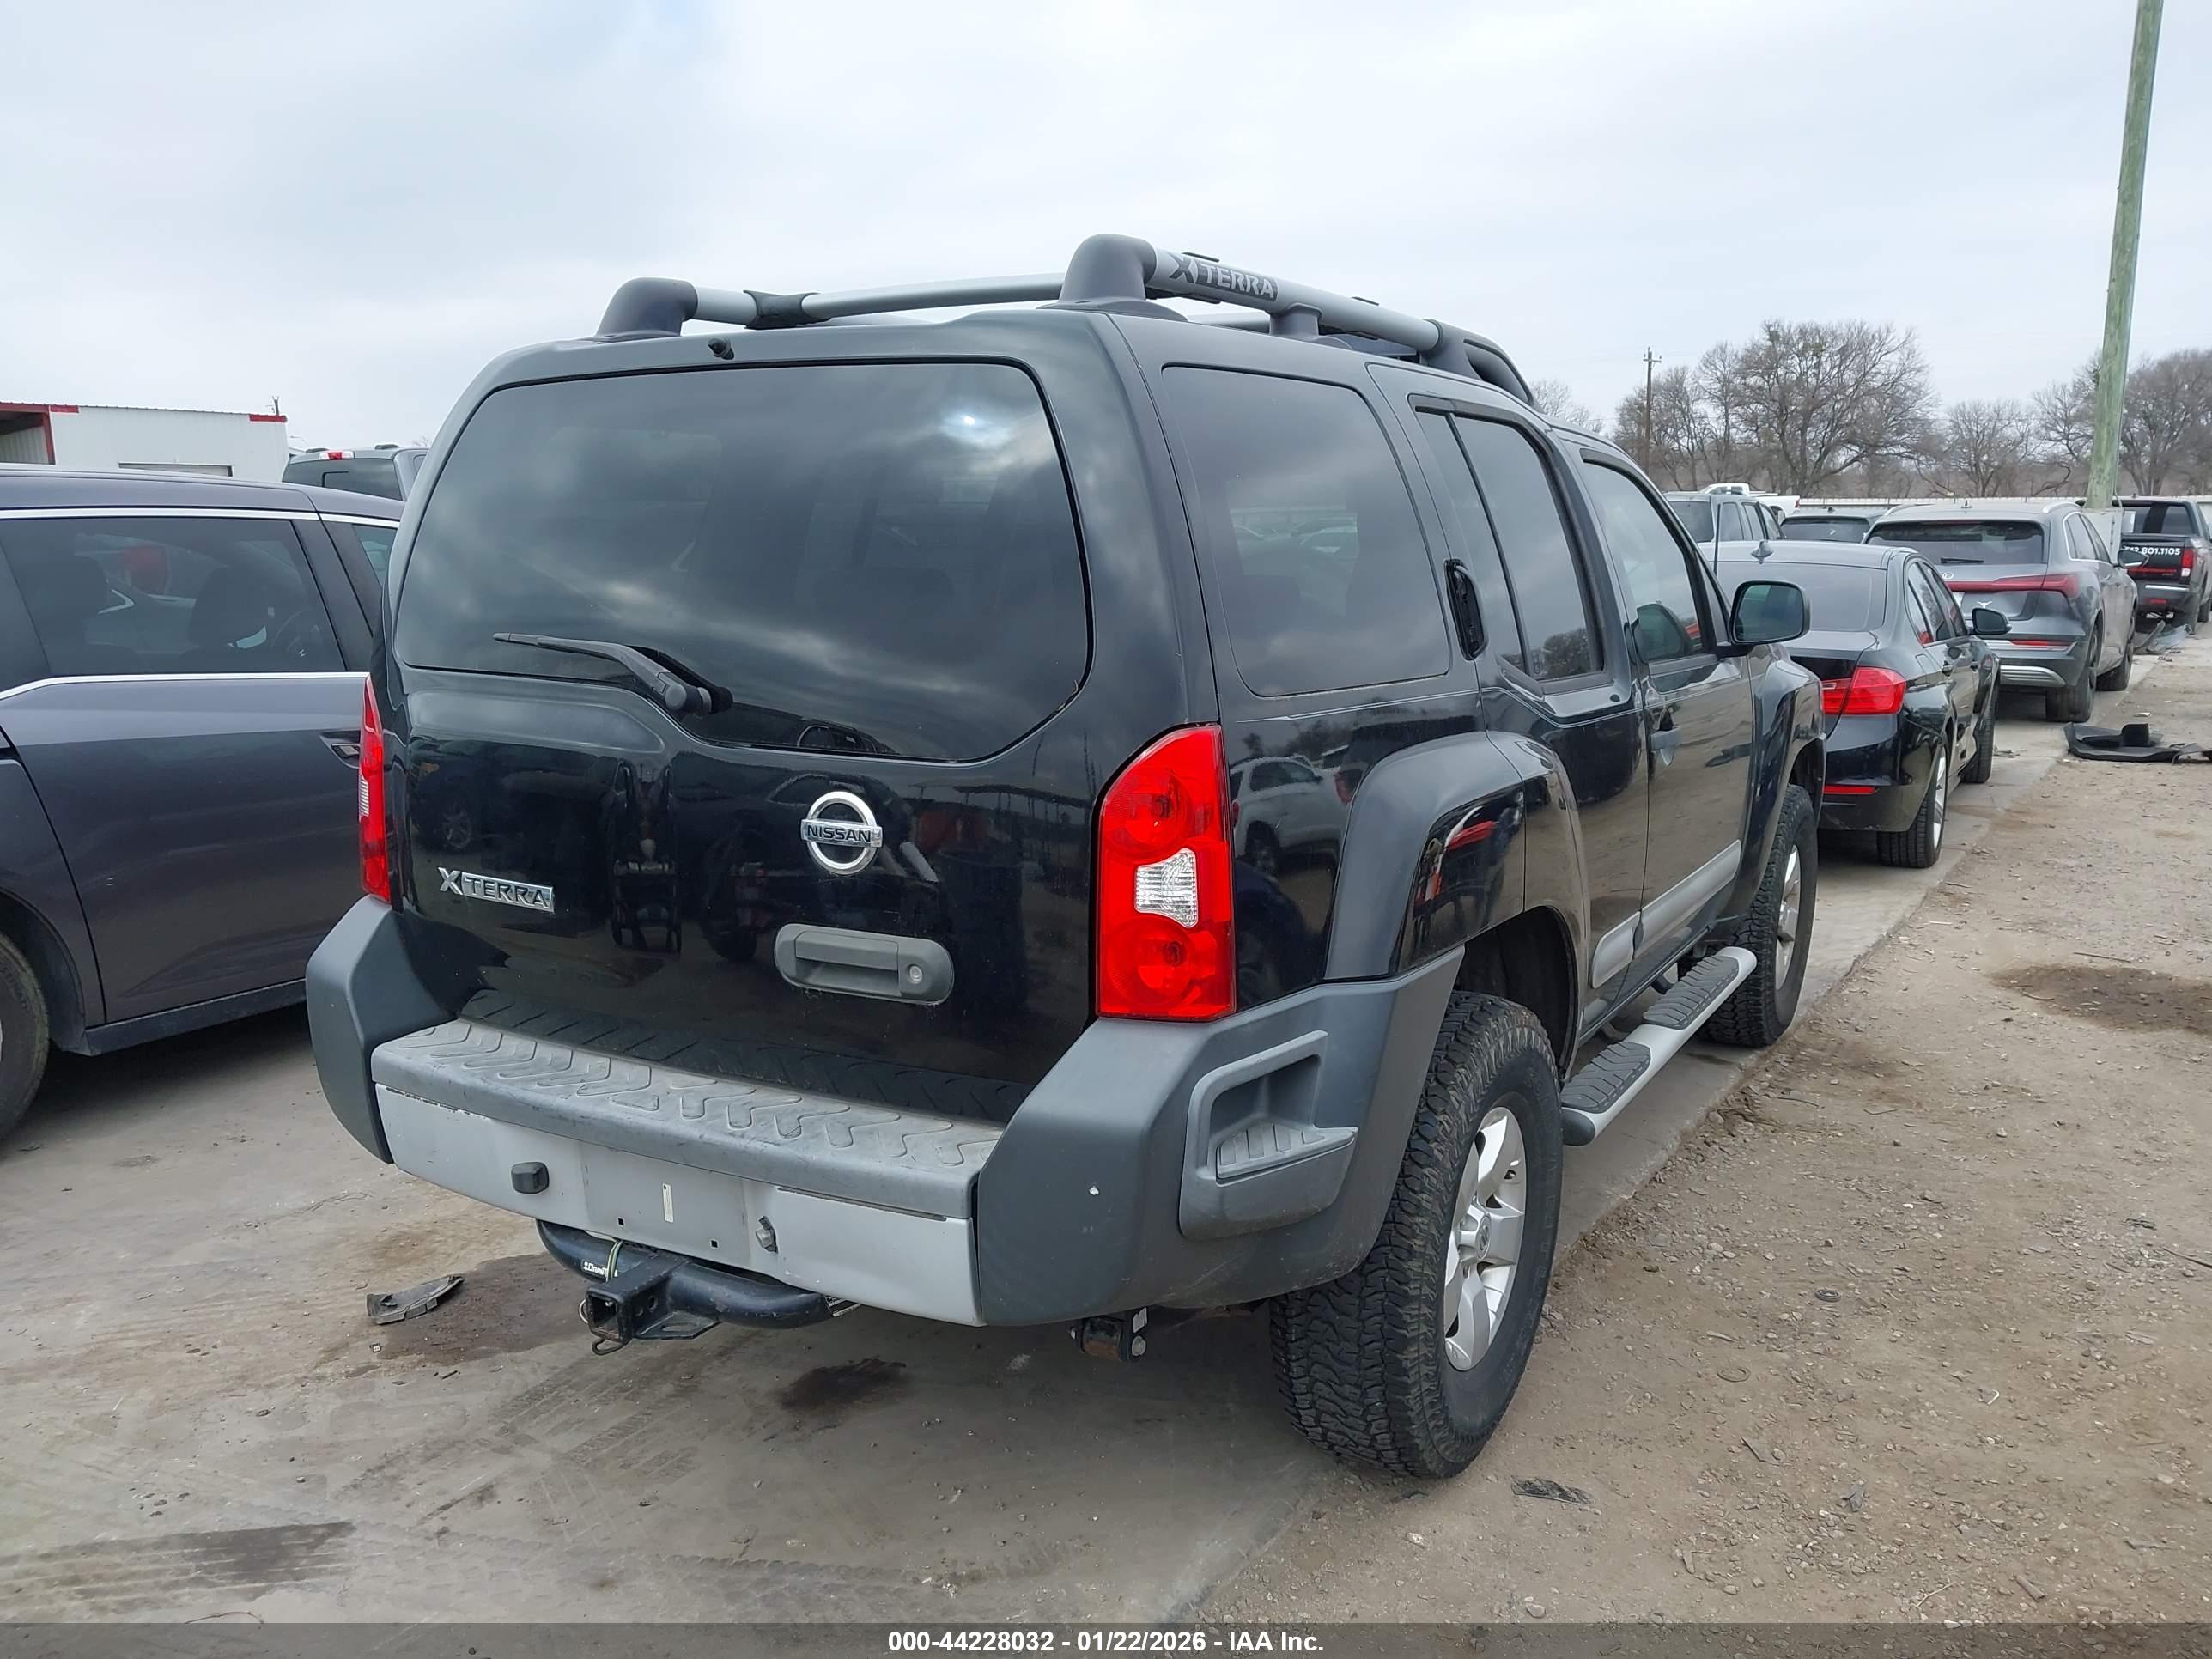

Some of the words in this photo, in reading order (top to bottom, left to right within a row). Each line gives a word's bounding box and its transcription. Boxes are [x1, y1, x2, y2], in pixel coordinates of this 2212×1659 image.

[1166, 252, 1277, 300] XTERRA
[806, 825, 872, 842] NISSAN
[438, 866, 553, 911] XTERRA
